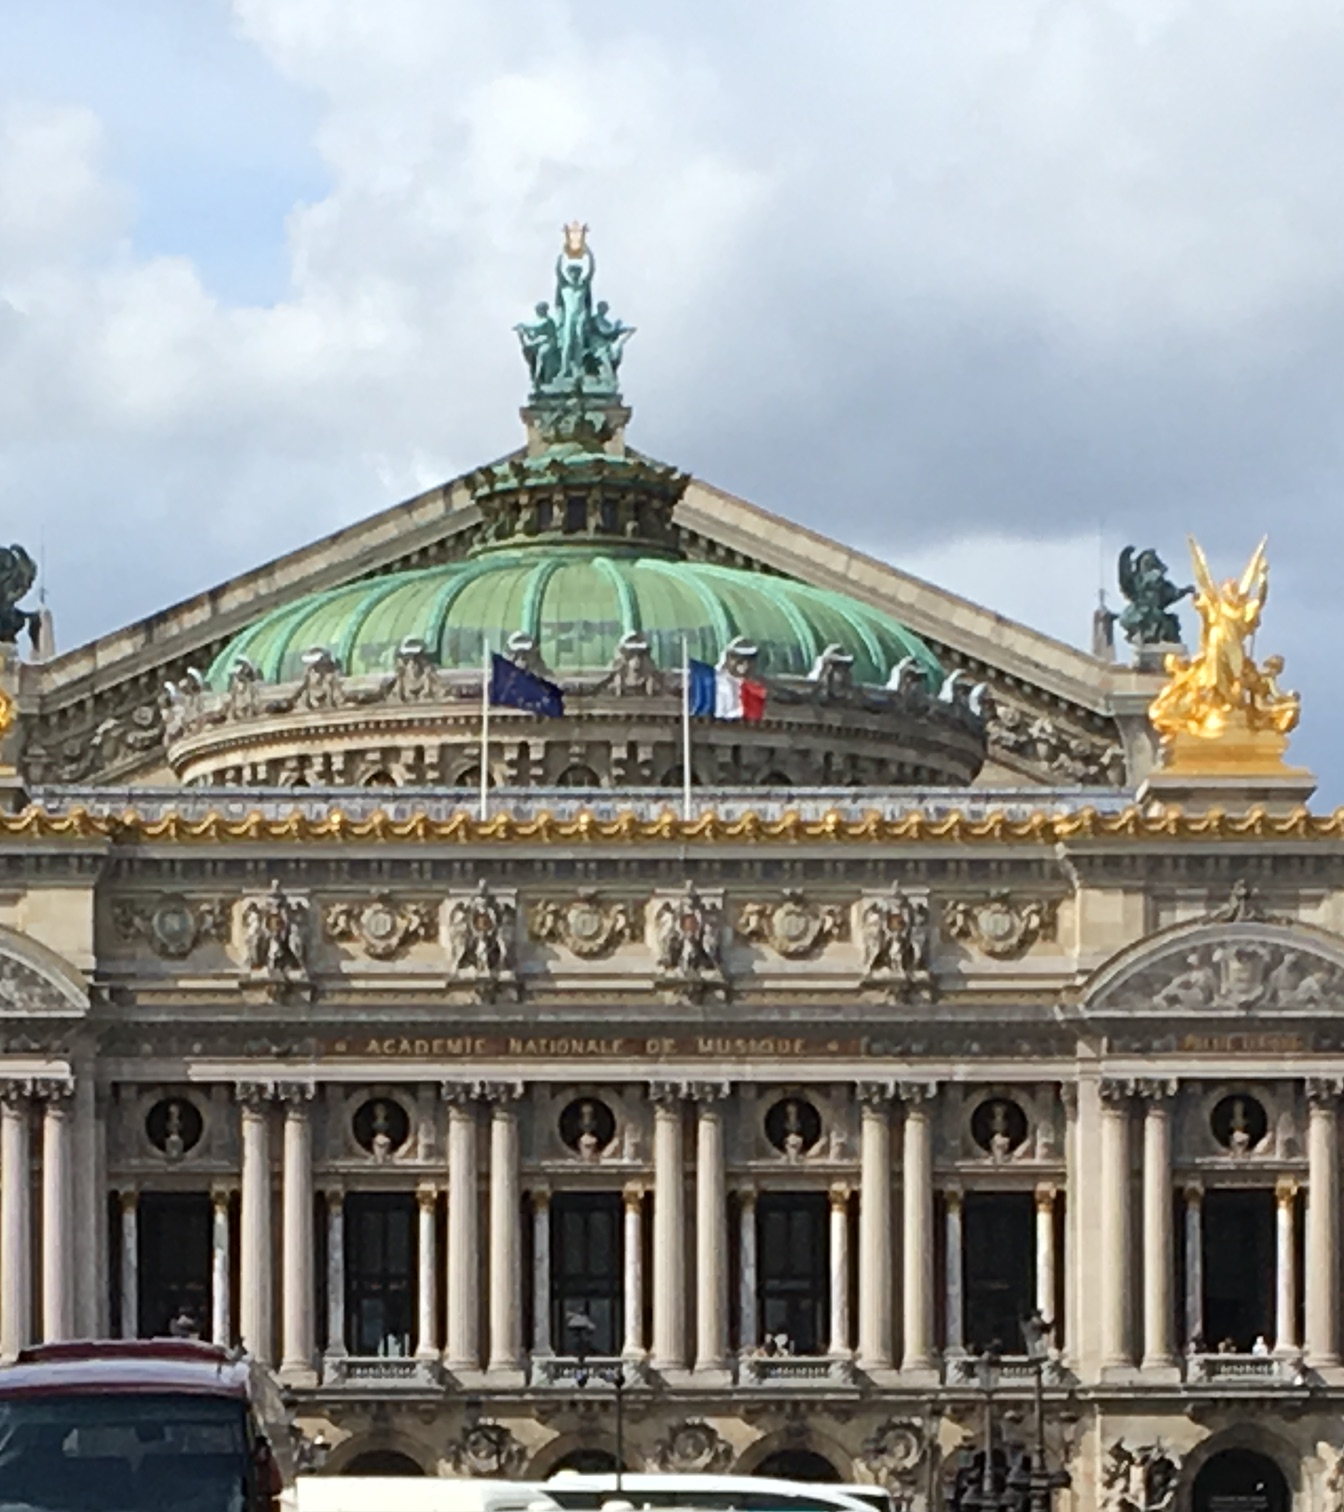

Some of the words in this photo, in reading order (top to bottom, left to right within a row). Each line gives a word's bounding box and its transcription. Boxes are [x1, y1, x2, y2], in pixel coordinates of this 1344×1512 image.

[509, 1038, 623, 1054] NATIONALE
[646, 1038, 677, 1054] DE
[698, 1037, 805, 1054] MUSIQUE
